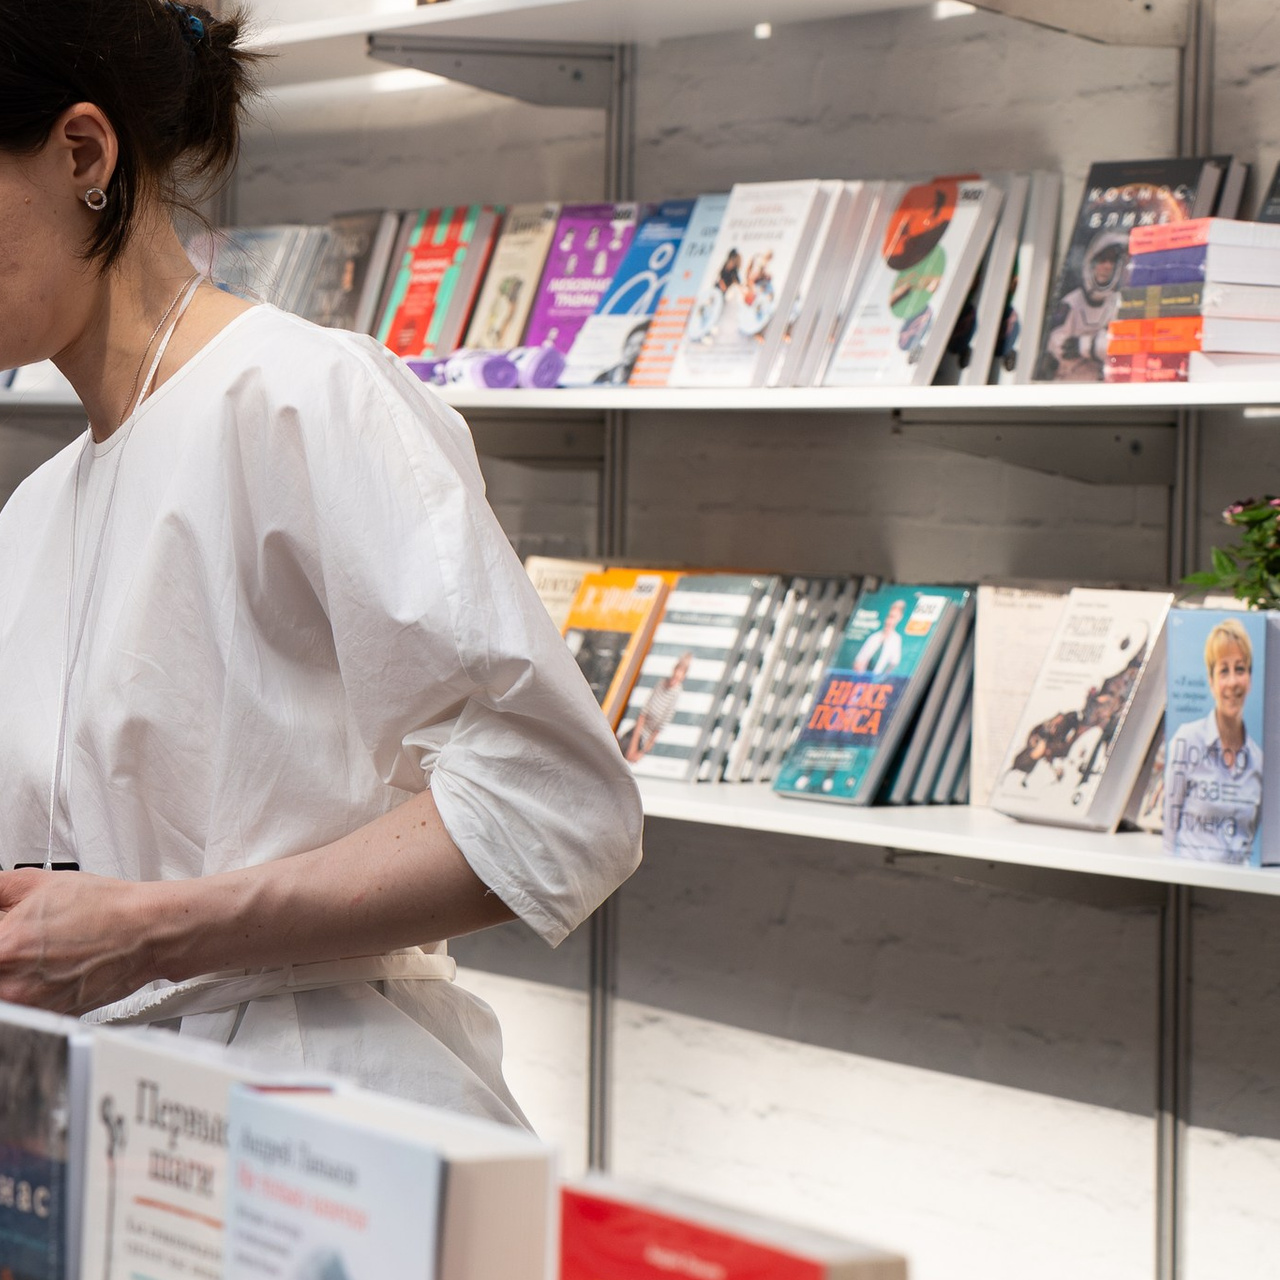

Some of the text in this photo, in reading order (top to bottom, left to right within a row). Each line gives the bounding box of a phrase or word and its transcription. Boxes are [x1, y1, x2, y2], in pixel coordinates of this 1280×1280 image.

[823, 680, 894, 711] НИЖЕ
[808, 703, 883, 736] ПОЯСА
[1172, 737, 1251, 778] Доктор
[1170, 771, 1220, 802] Лиза
[1170, 805, 1238, 837] Глинка
